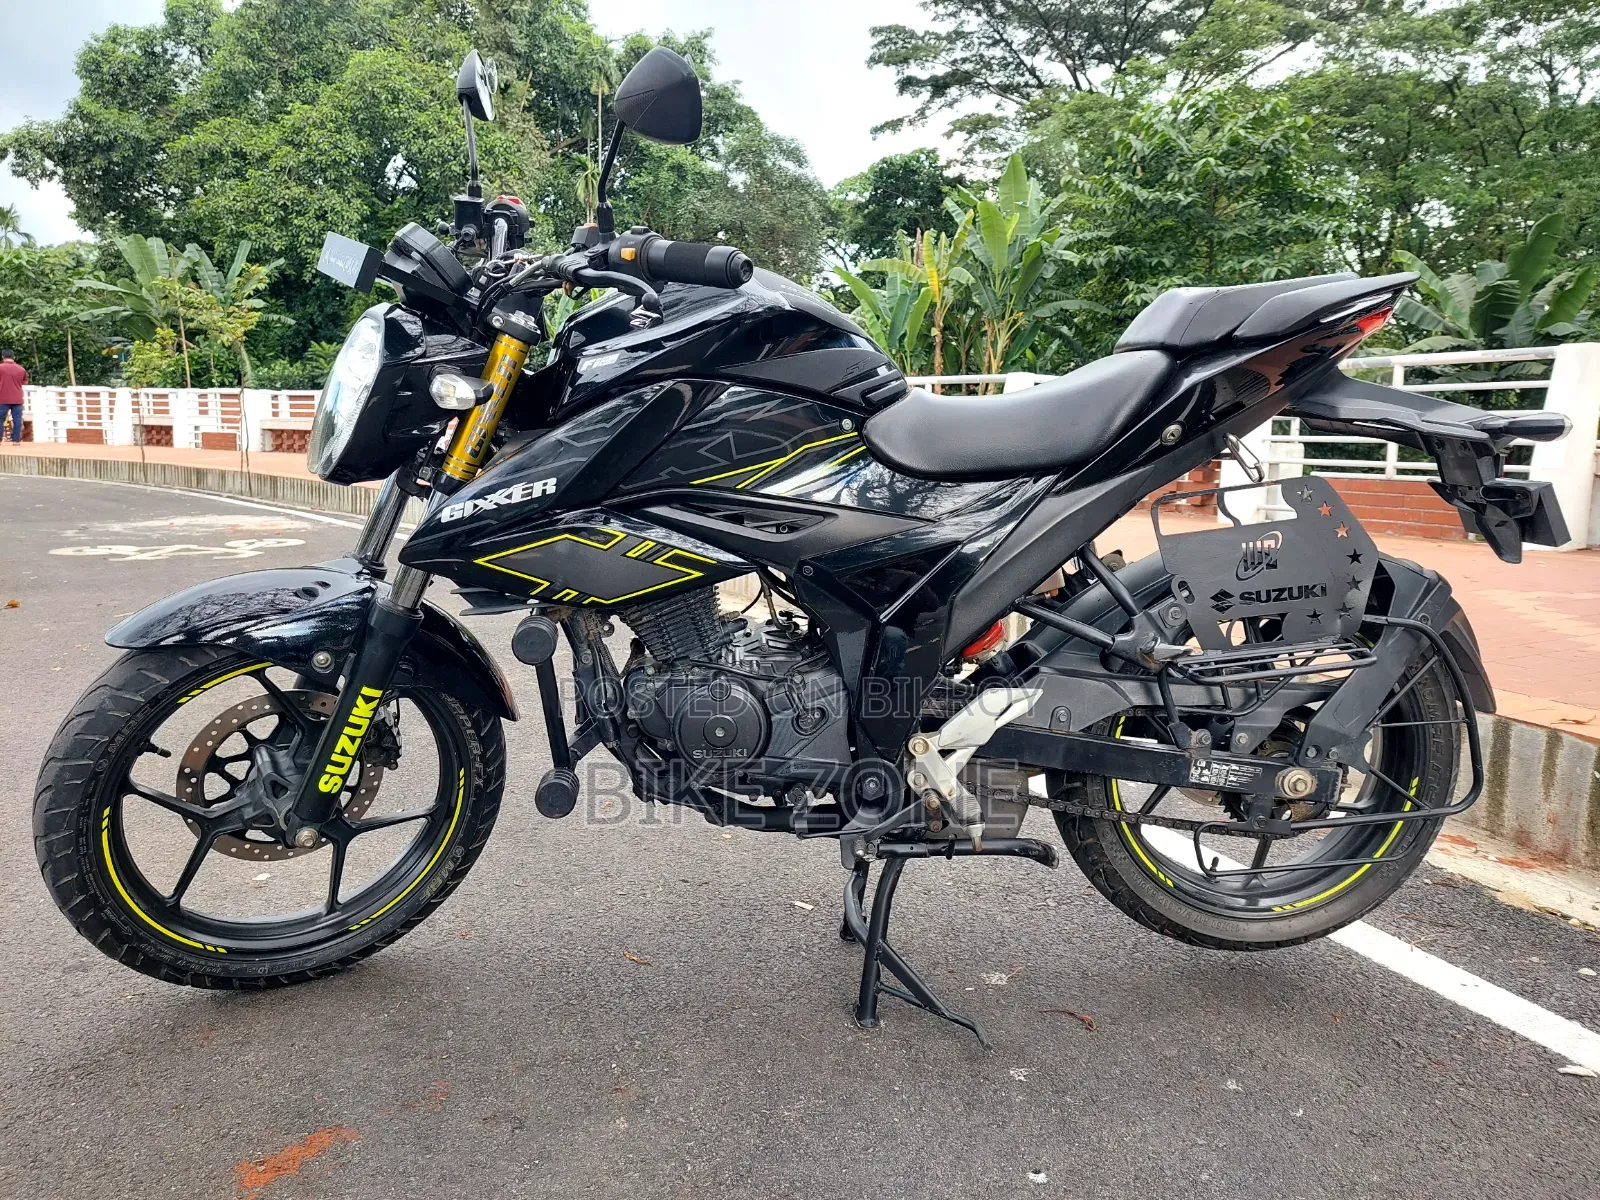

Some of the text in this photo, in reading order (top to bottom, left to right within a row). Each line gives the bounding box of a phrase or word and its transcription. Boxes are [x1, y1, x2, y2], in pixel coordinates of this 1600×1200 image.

[440, 477, 557, 524] GIXXER
[1239, 583, 1327, 605] SUZUKI
[318, 685, 384, 794] SUZUKI
[692, 748, 748, 759] SUZUKI
